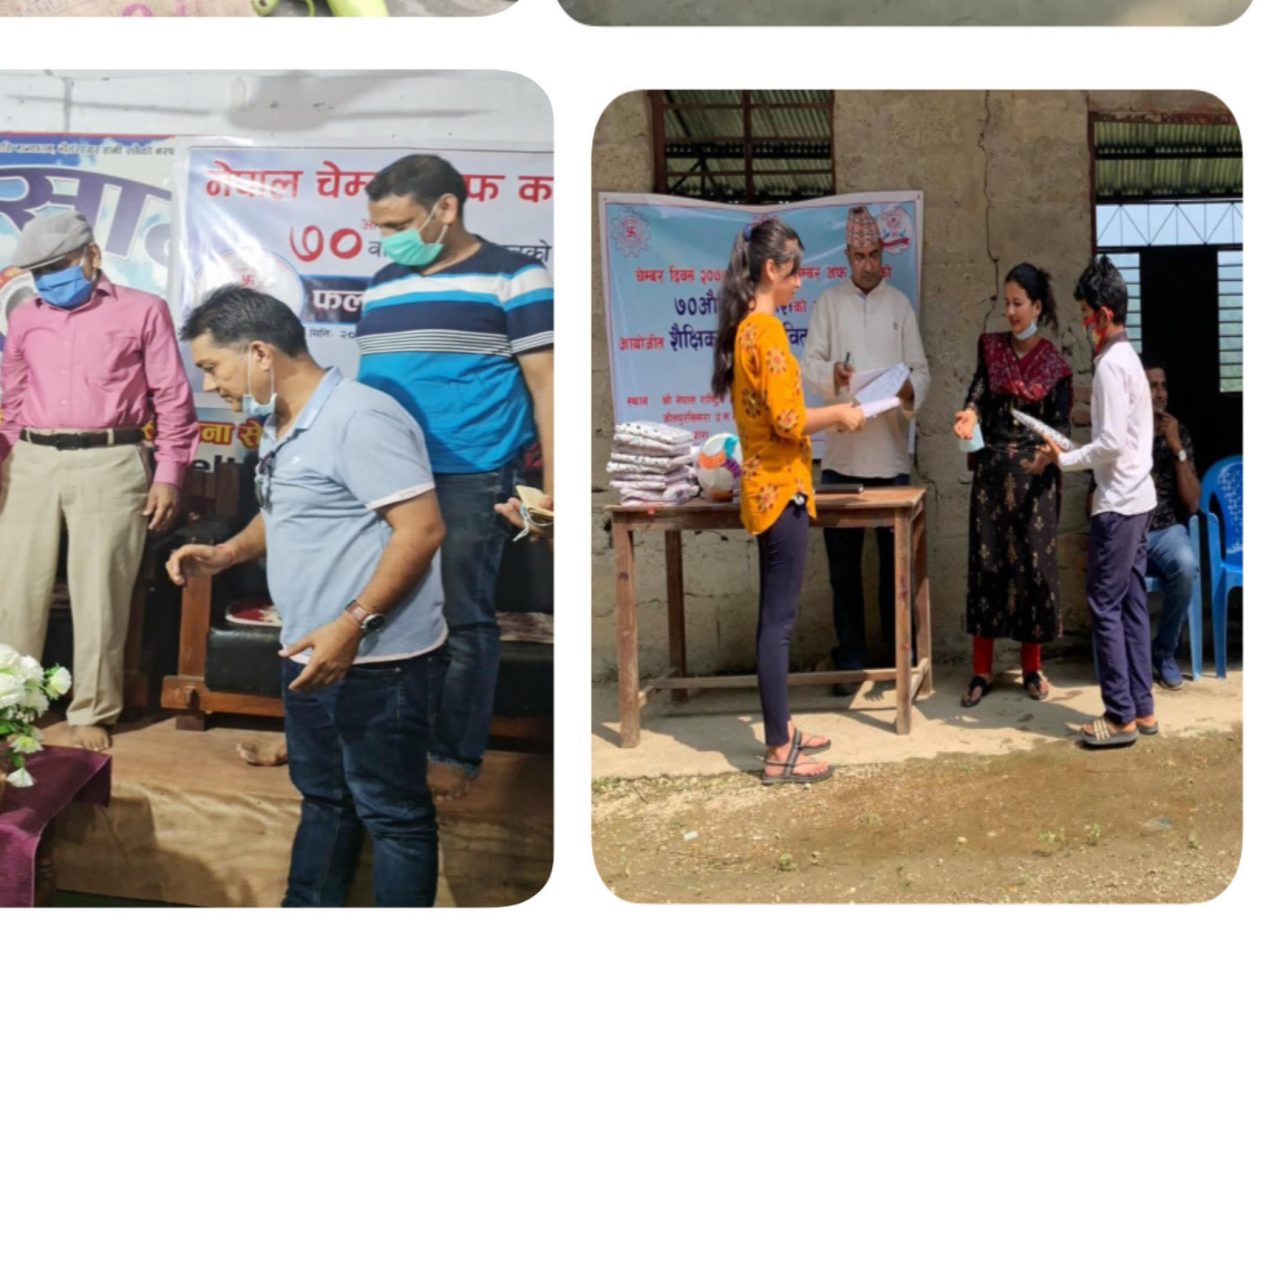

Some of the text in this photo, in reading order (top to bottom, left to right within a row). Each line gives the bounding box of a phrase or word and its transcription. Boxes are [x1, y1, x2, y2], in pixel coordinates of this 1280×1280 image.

[206, 160, 303, 199] नेपाल
[316, 160, 372, 198] चेम
[289, 224, 363, 262] ७०
